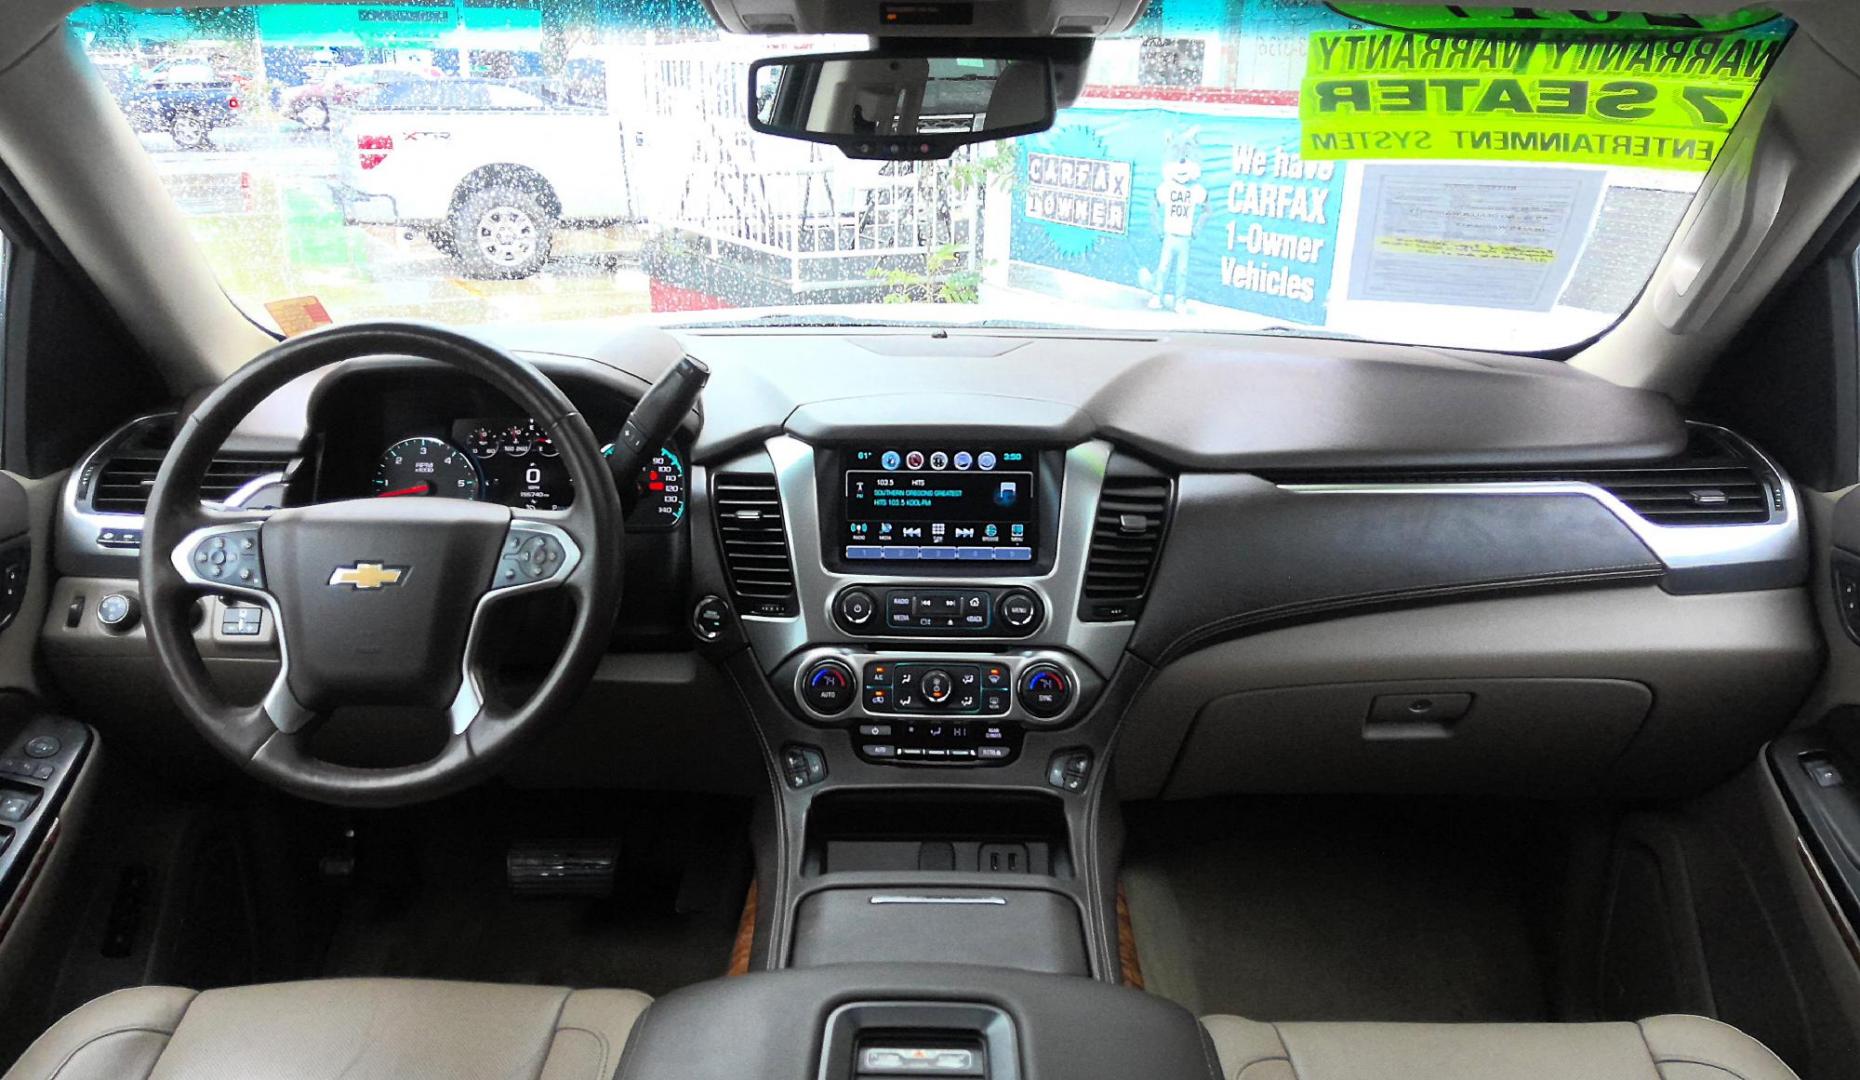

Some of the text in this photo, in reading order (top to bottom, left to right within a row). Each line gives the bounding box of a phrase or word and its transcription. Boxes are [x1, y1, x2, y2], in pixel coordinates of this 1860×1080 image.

[1231, 144, 1267, 177] We
[1029, 156, 1124, 196] CARFAX
[1227, 178, 1329, 225] CARFAX
[1170, 204, 1190, 218] FOX
[1225, 219, 1325, 264] 1-Owner
[1220, 255, 1315, 303] Vehicles
[420, 447, 427, 455] 3
[395, 456, 403, 465] 2
[444, 456, 452, 465] 4
[652, 457, 664, 465] 90
[526, 468, 541, 483] 0
[384, 479, 389, 487] 1
[457, 480, 465, 488] 5
[664, 495, 678, 503] 130
